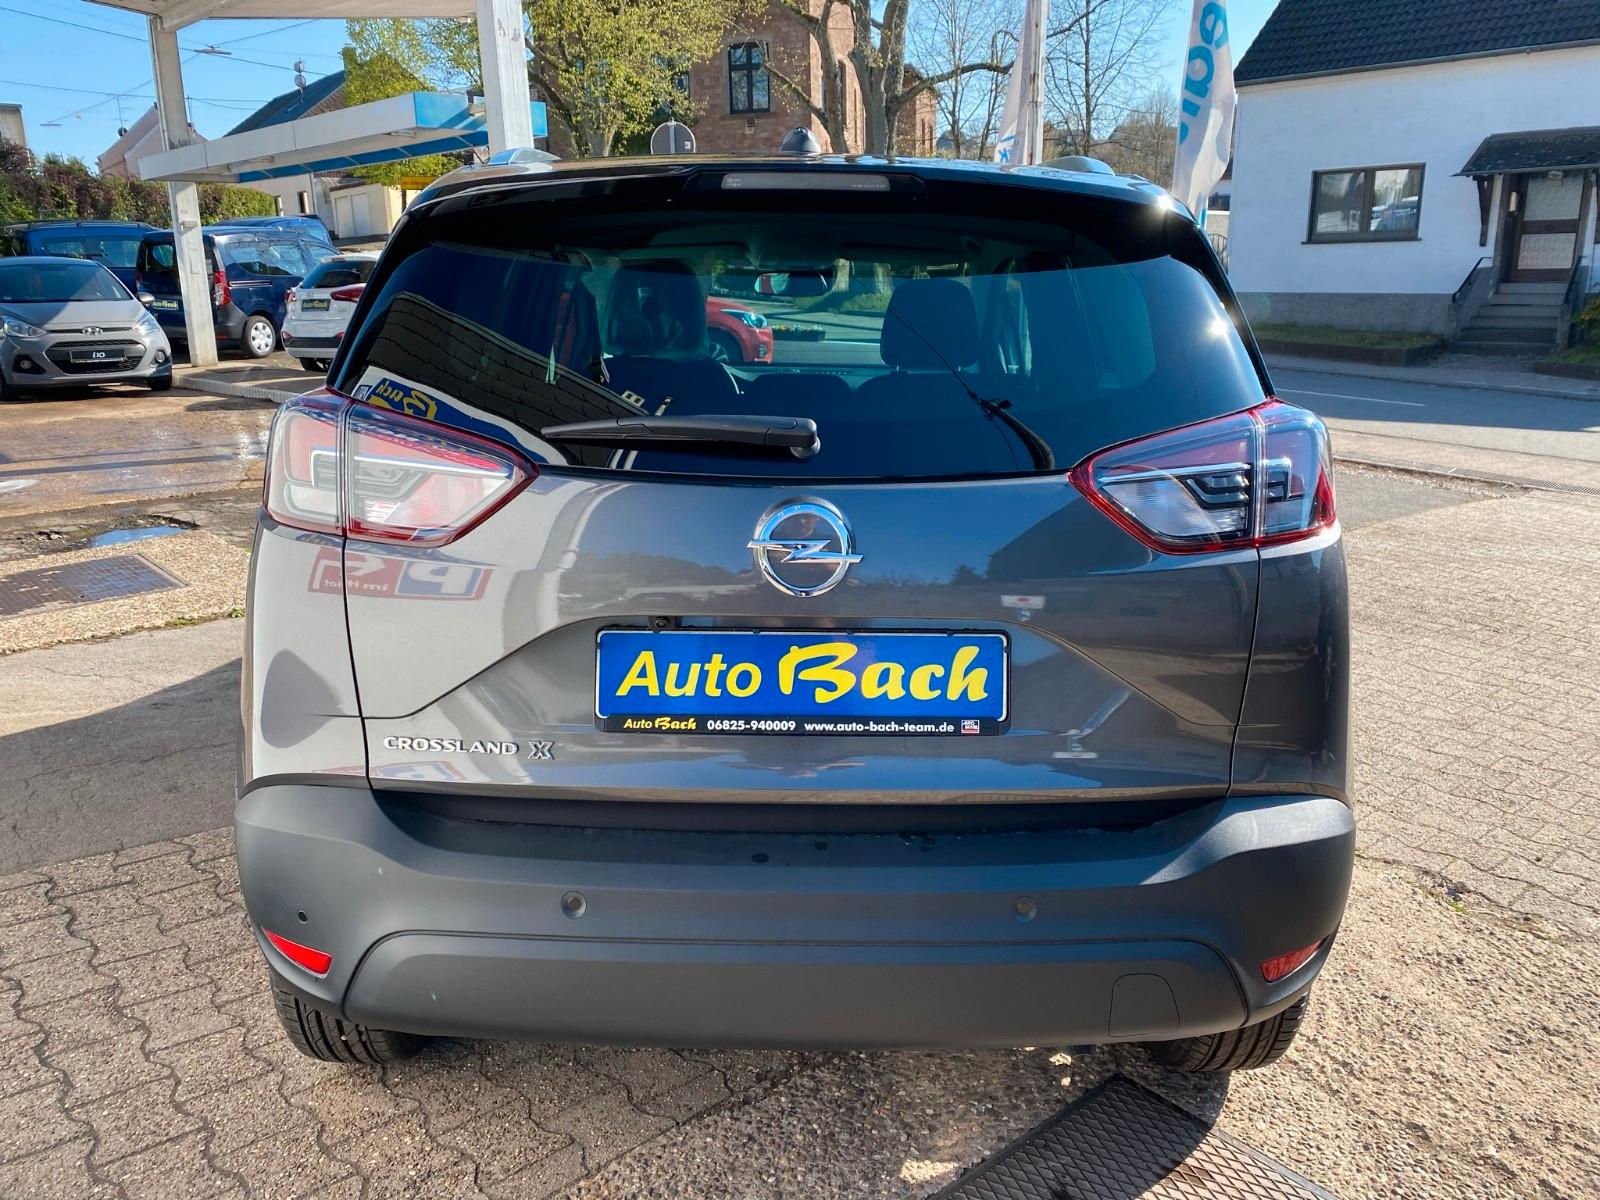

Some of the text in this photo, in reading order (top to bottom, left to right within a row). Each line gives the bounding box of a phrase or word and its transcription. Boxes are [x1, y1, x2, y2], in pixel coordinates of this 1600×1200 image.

[615, 642, 989, 704] Auto Bach
[623, 718, 652, 730] Auto
[654, 716, 697, 731] Bach
[706, 719, 797, 732] 06825-940009
[803, 720, 955, 733] www.auto-bach-team.de
[383, 735, 555, 760] CROSSLAND X
